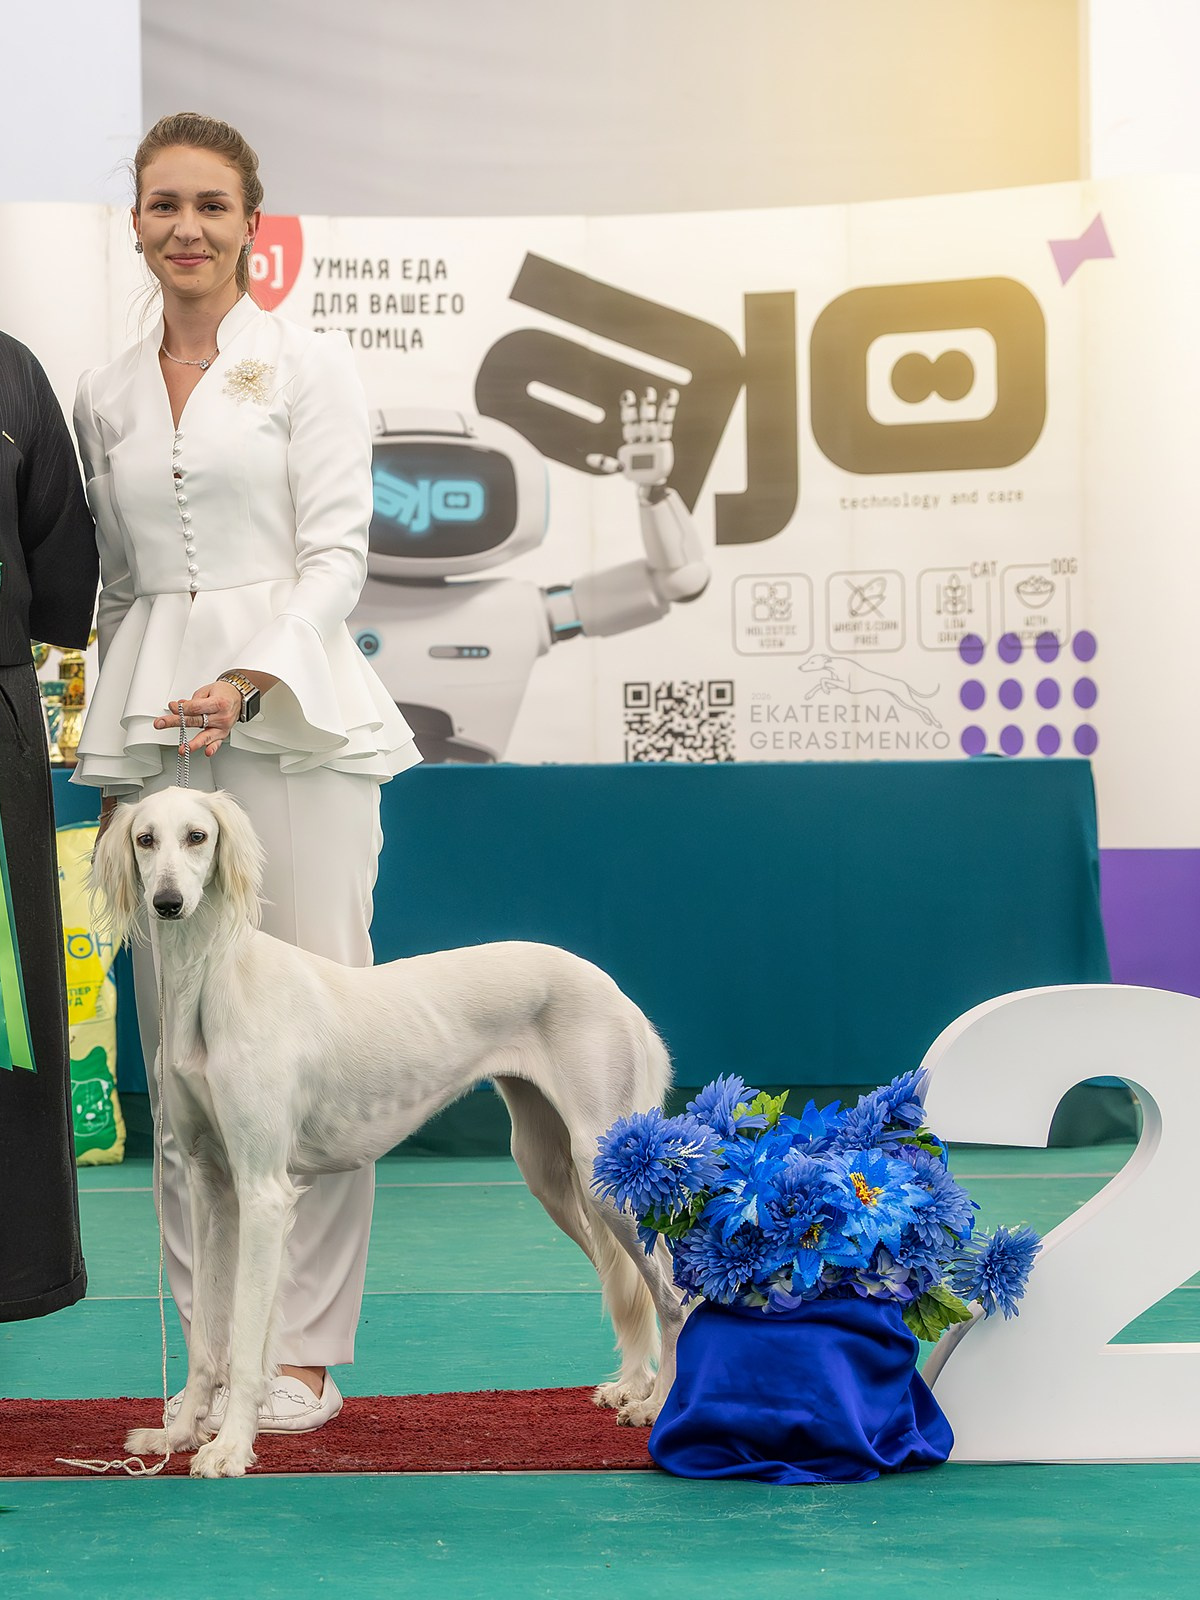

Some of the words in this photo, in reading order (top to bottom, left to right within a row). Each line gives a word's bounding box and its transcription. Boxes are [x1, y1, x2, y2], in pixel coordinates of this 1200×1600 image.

[313, 257, 390, 280] УМНАЯ
[402, 258, 448, 283] ЕДА
[312, 293, 359, 317] ДЛЯ
[370, 293, 466, 315] ВАШЕГО
[313, 327, 424, 352] ТОМЦА
[840, 492, 940, 510] technology
[952, 490, 978, 505] and
[987, 489, 1024, 504] care
[970, 561, 998, 578] CAT
[1051, 558, 1078, 575] DOG
